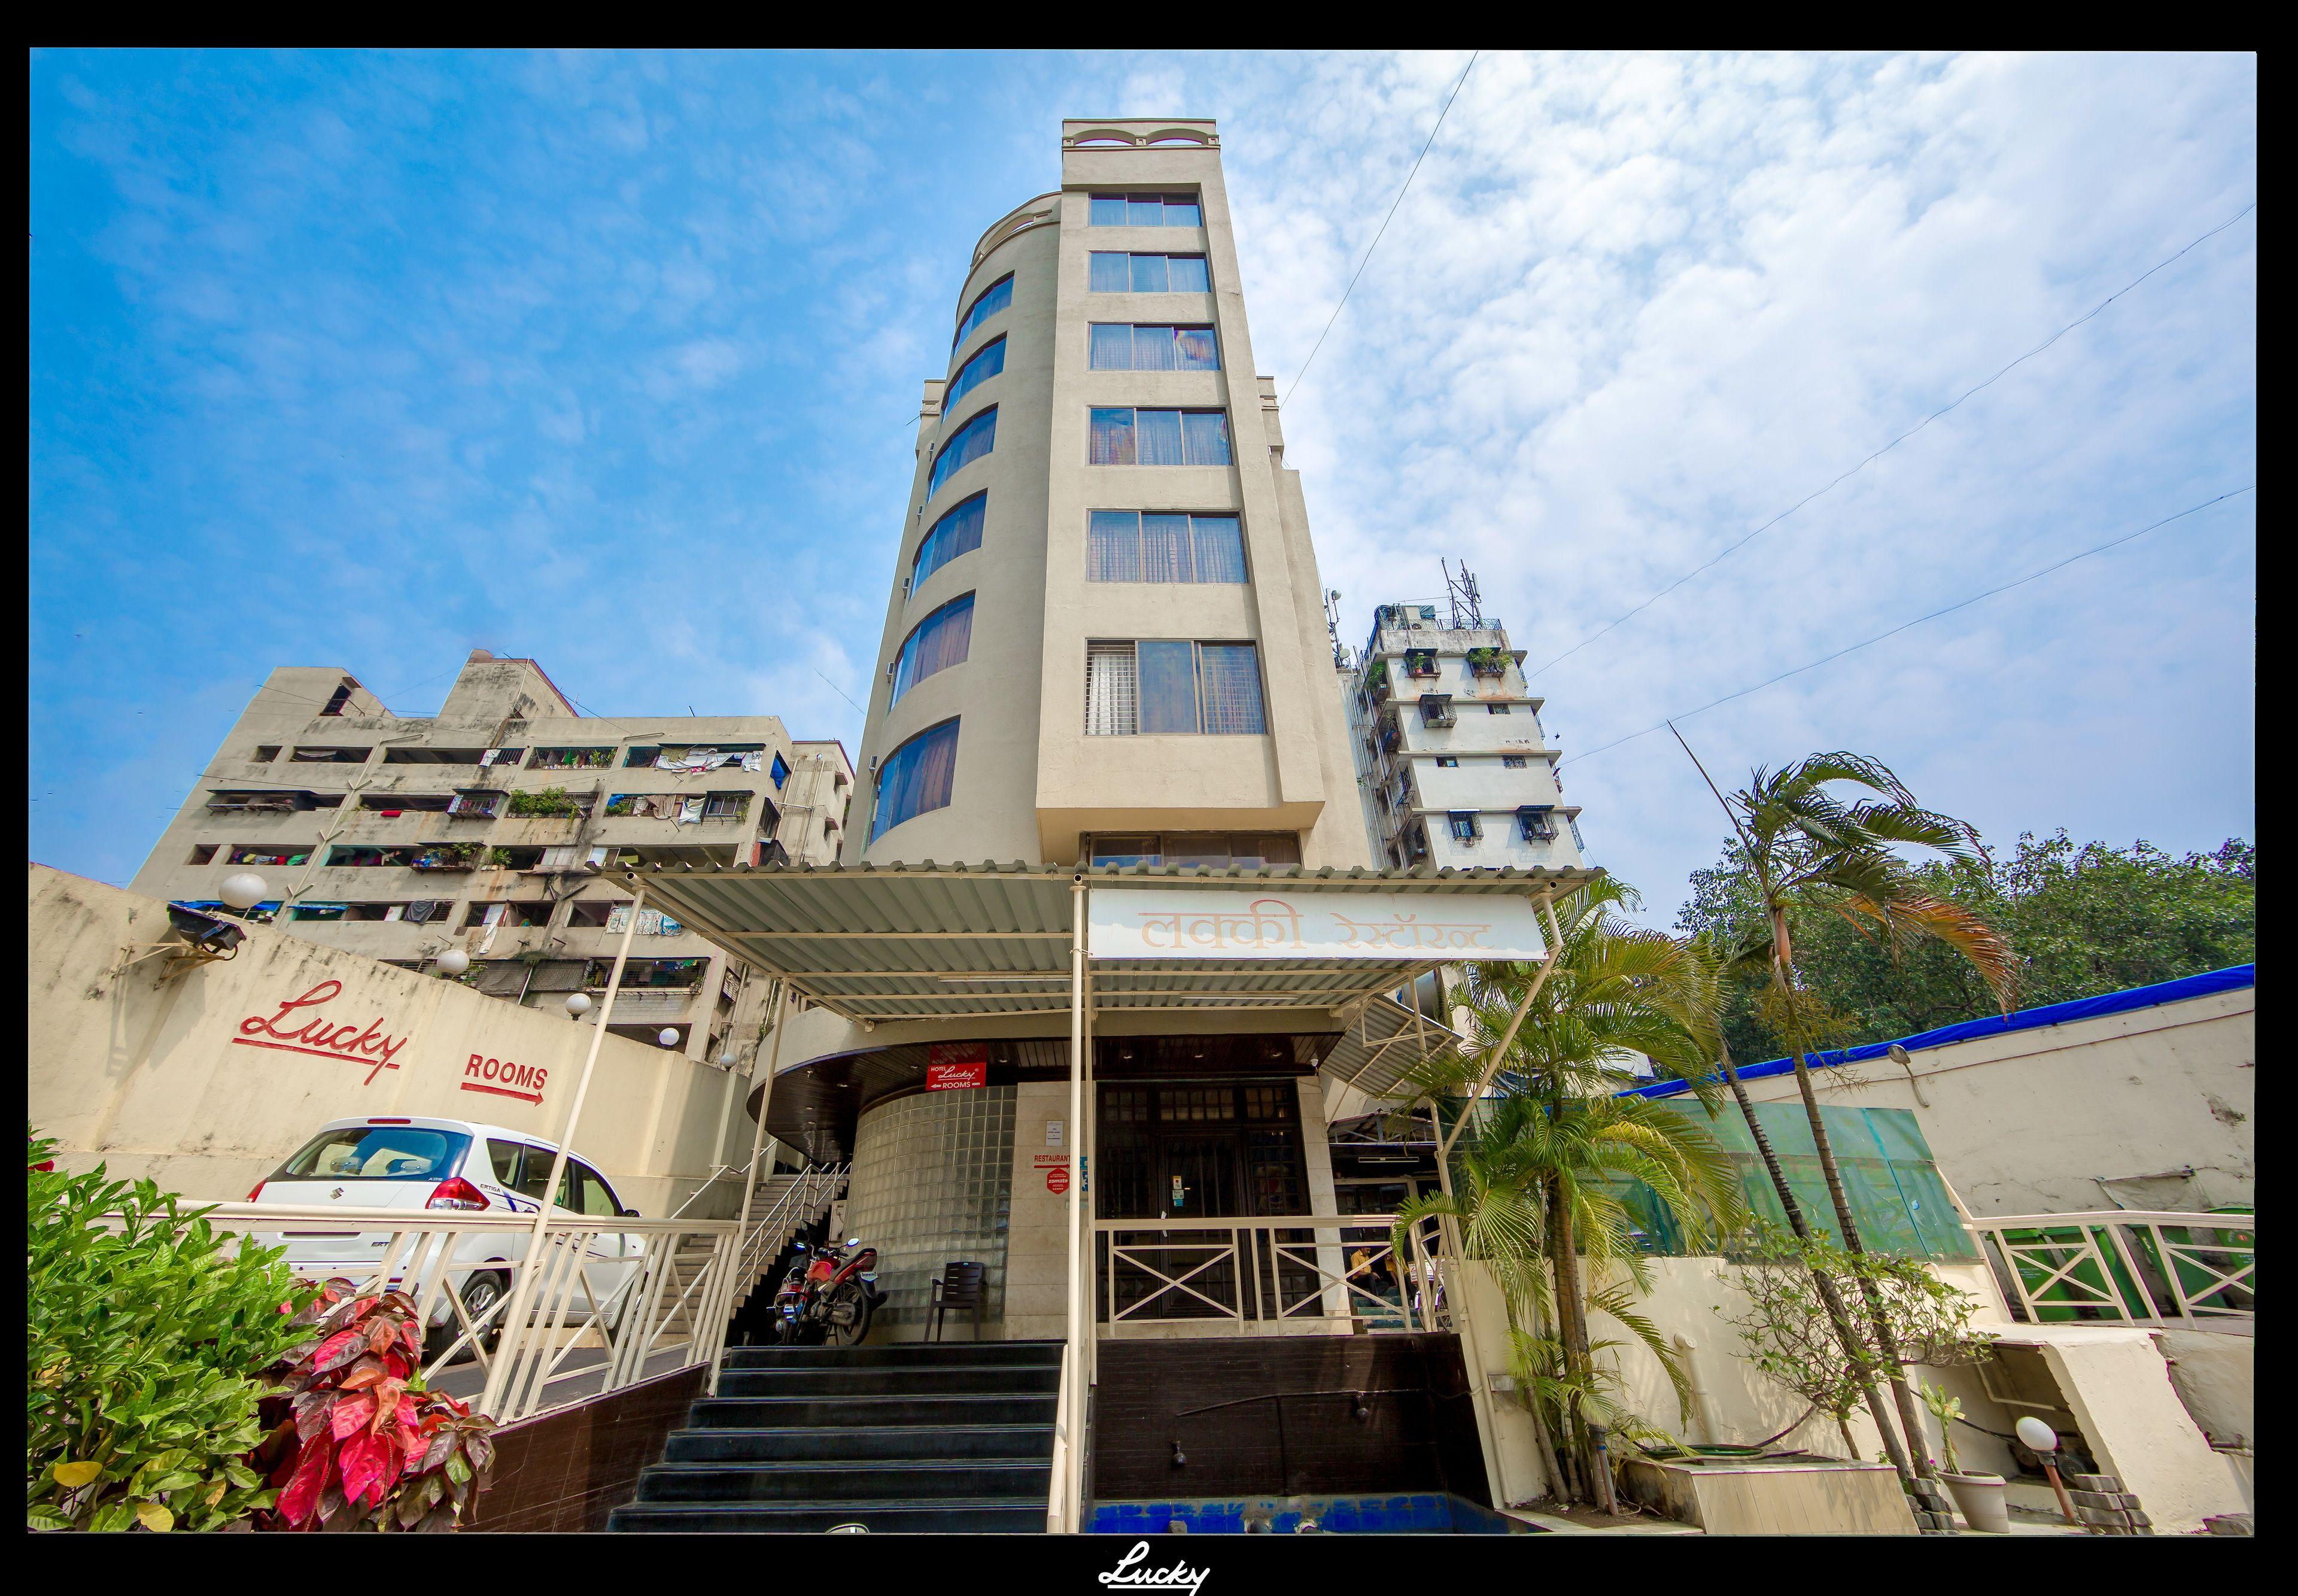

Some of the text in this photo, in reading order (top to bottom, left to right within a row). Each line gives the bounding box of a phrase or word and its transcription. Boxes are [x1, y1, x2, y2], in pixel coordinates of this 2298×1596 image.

[1138, 899, 1308, 949] लक्की
[240, 980, 408, 1086] Lucky
[464, 1054, 548, 1090] ROOMS
[938, 1065, 975, 1081] Lucky
[480, 1184, 501, 1193] ERTIGA
